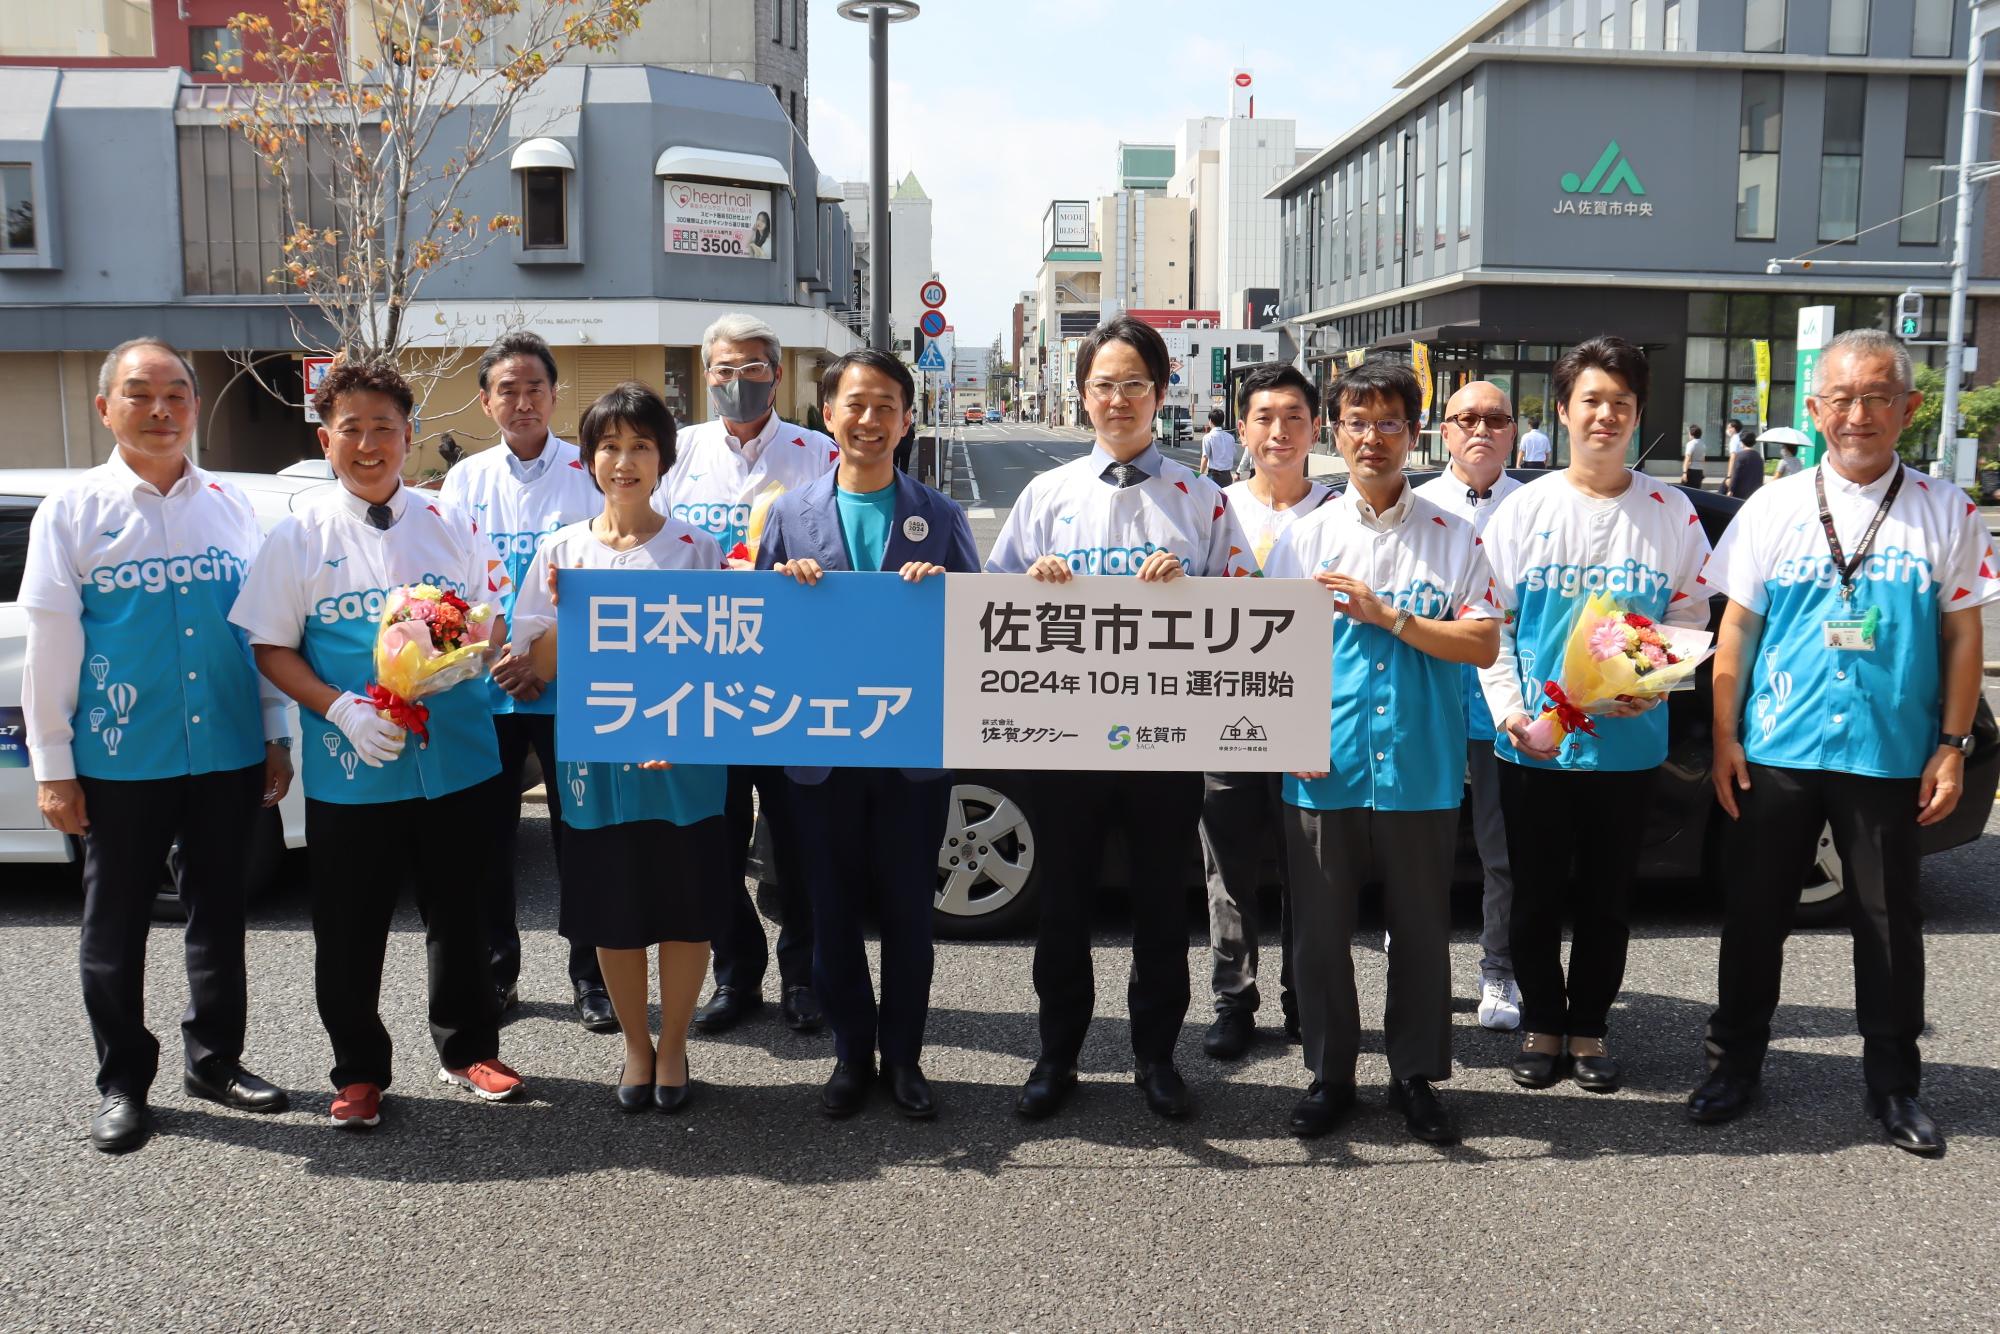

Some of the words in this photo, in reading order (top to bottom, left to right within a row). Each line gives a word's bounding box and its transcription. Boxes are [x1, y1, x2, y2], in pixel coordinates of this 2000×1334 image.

[1553, 199, 1576, 214] JA
[1578, 200, 1653, 217] 佐賀市中央
[926, 288, 941, 301] 40
[93, 546, 250, 594] sagacity
[589, 594, 764, 655] 日本版
[979, 601, 1296, 655] 佐賀市エリア
[586, 681, 913, 739] ライドシェア
[982, 727, 1078, 743] 佐賀タクシー
[1136, 726, 1187, 743] 佐賀市
[1230, 728, 1258, 740] 中央
